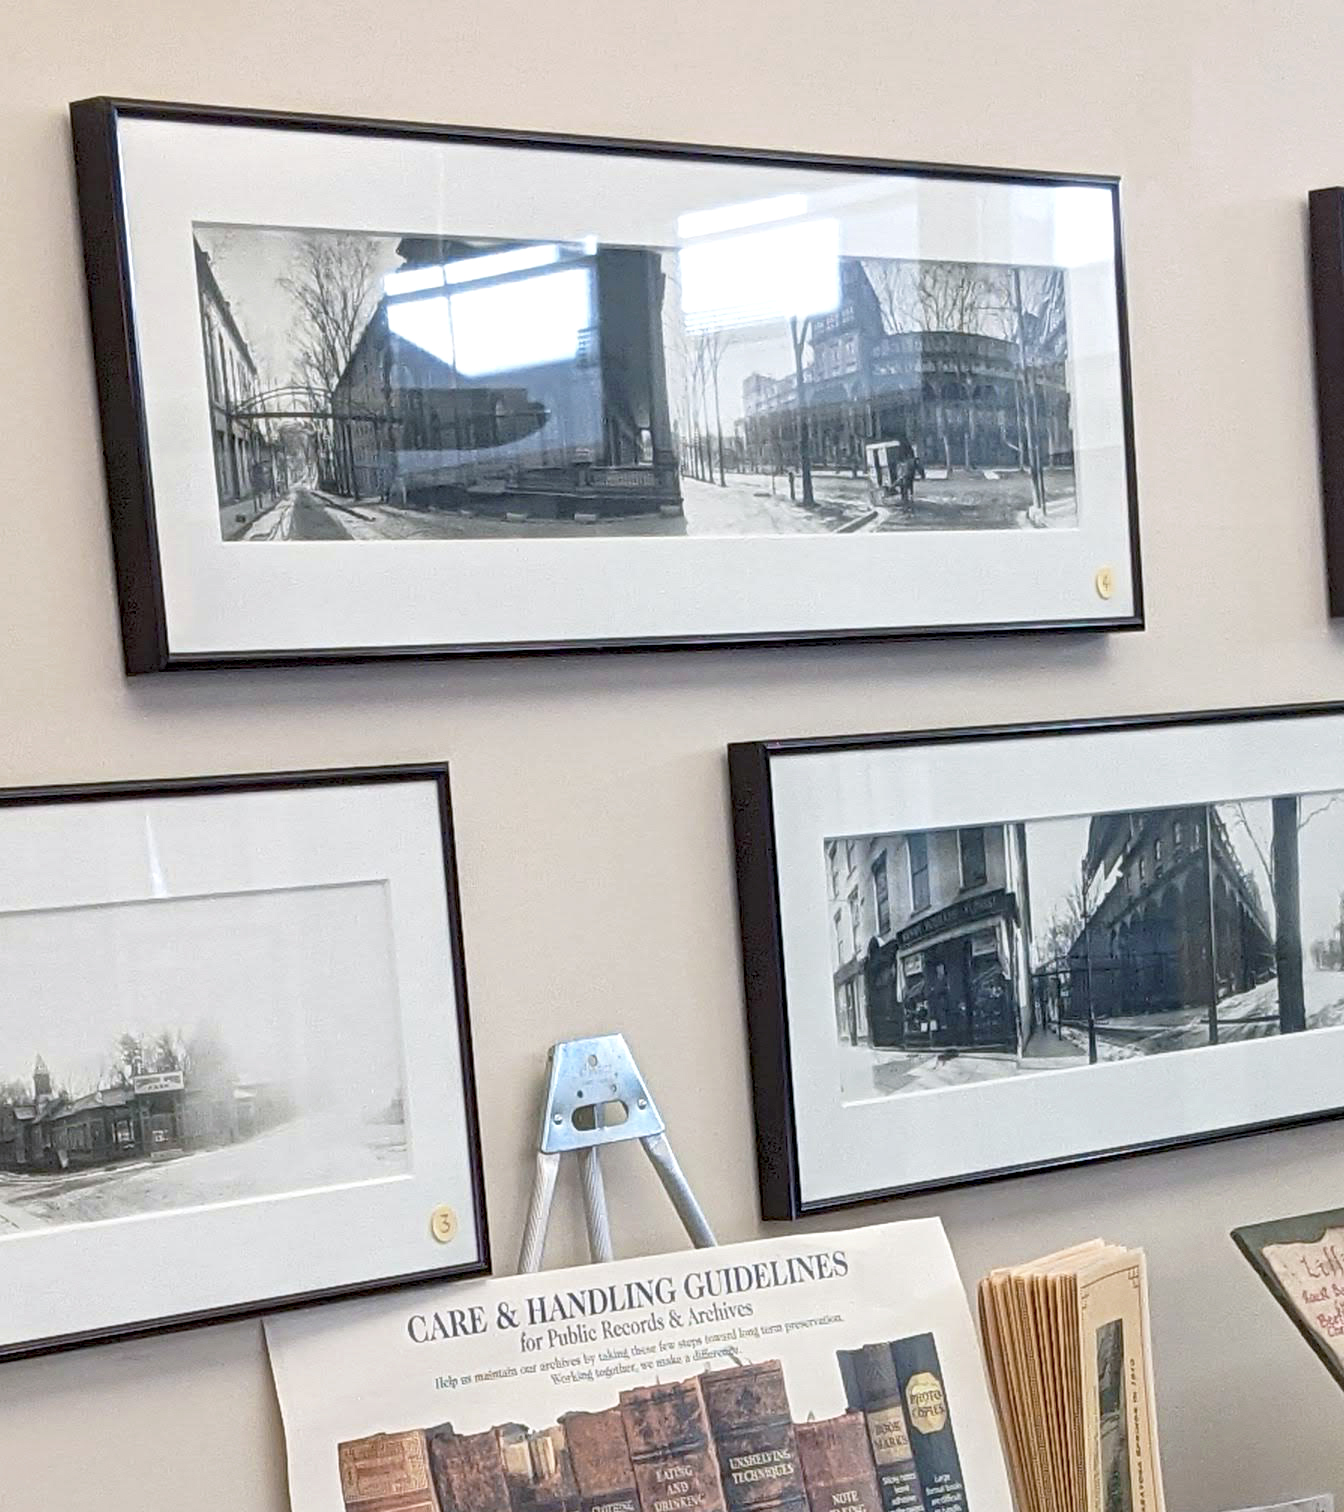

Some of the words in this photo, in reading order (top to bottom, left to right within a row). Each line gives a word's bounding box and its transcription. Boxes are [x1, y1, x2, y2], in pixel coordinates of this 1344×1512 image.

[439, 1213, 451, 1234] 3
[408, 1305, 488, 1343] CARE
[497, 1301, 520, 1331] &
[527, 1277, 677, 1326] HANDLING
[684, 1250, 849, 1300] GUIDELINES
[520, 1332, 544, 1353] for
[548, 1323, 598, 1350] Public
[601, 1312, 664, 1338] Records
[669, 1309, 684, 1328] &
[688, 1300, 754, 1327] Archives
[435, 1375, 458, 1390] Help
[461, 1373, 472, 1385] us
[474, 1365, 518, 1384] maintain
[520, 1364, 537, 1375] our
[540, 1354, 581, 1372] archives
[583, 1353, 596, 1367] by
[598, 1346, 629, 1362] taking
[631, 1342, 656, 1357] these
[659, 1339, 675, 1351] few
[678, 1334, 702, 1350] steps
[705, 1329, 737, 1345] toward
[739, 1324, 760, 1341] long
[761, 1323, 783, 1335] term
[785, 1313, 845, 1333] preservation.
[550, 1369, 593, 1386] Working
[595, 1363, 639, 1380] together,
[640, 1360, 654, 1371] we
[656, 1352, 682, 1367] make
[685, 1354, 692, 1363] a
[692, 1345, 743, 1362] difference.
[874, 1435, 908, 1450] MARKS
[729, 1449, 792, 1470] UNSHELVING
[656, 1465, 692, 1482] EATING
[731, 1463, 794, 1485] TECHNIQUES
[667, 1480, 689, 1496] AND
[831, 1491, 860, 1506] NOTE
